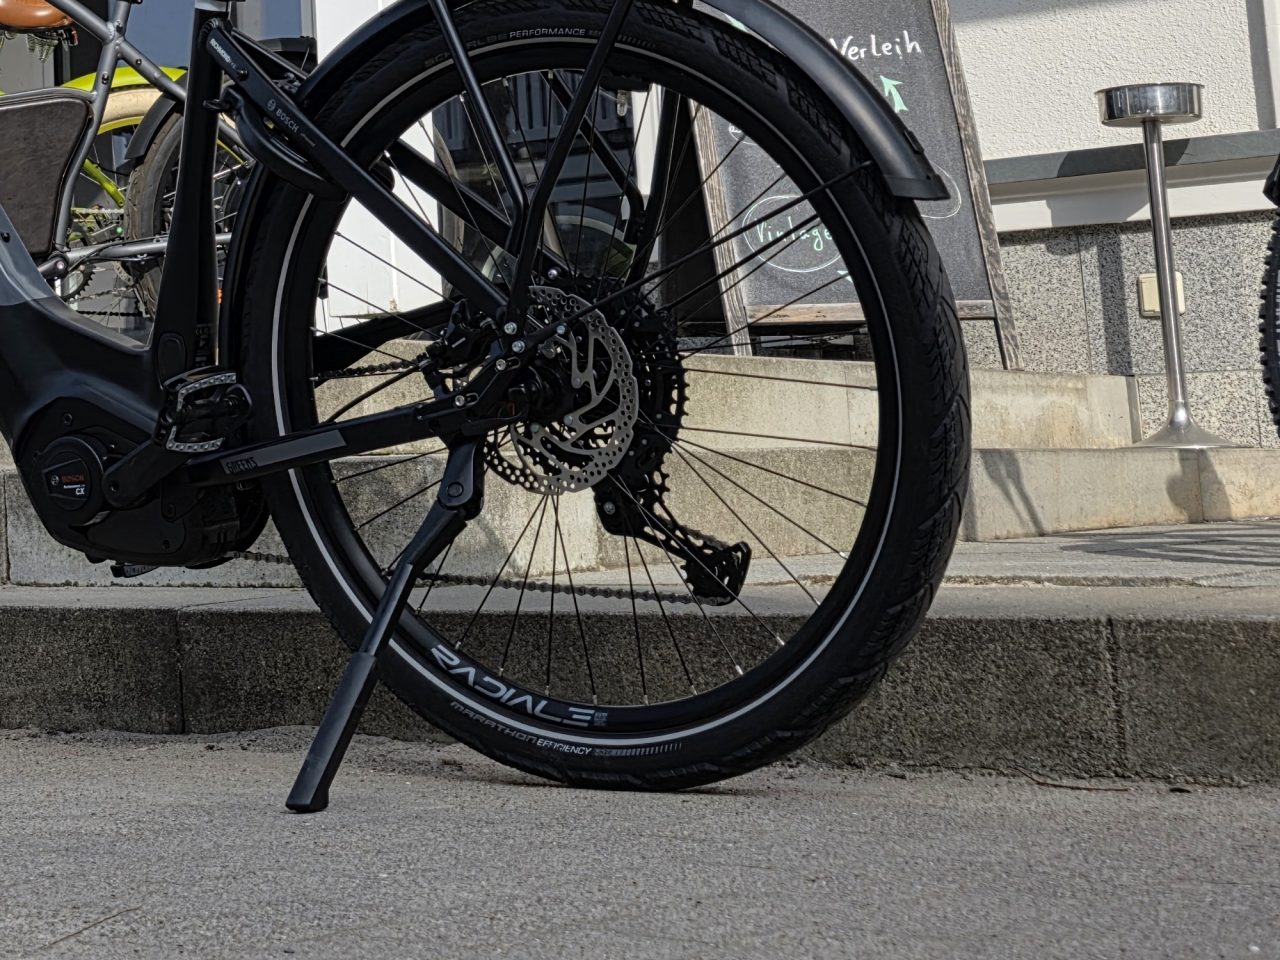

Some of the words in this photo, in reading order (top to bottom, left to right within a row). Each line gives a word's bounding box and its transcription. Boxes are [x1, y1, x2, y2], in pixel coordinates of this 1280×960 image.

[509, 27, 588, 39] PERFORMANCE
[829, 29, 922, 61] Verleih
[275, 108, 300, 133] BOSCH
[430, 644, 596, 728] RADIALE
[449, 700, 538, 745] MARATHON
[536, 738, 593, 756] EFFICIENCY
